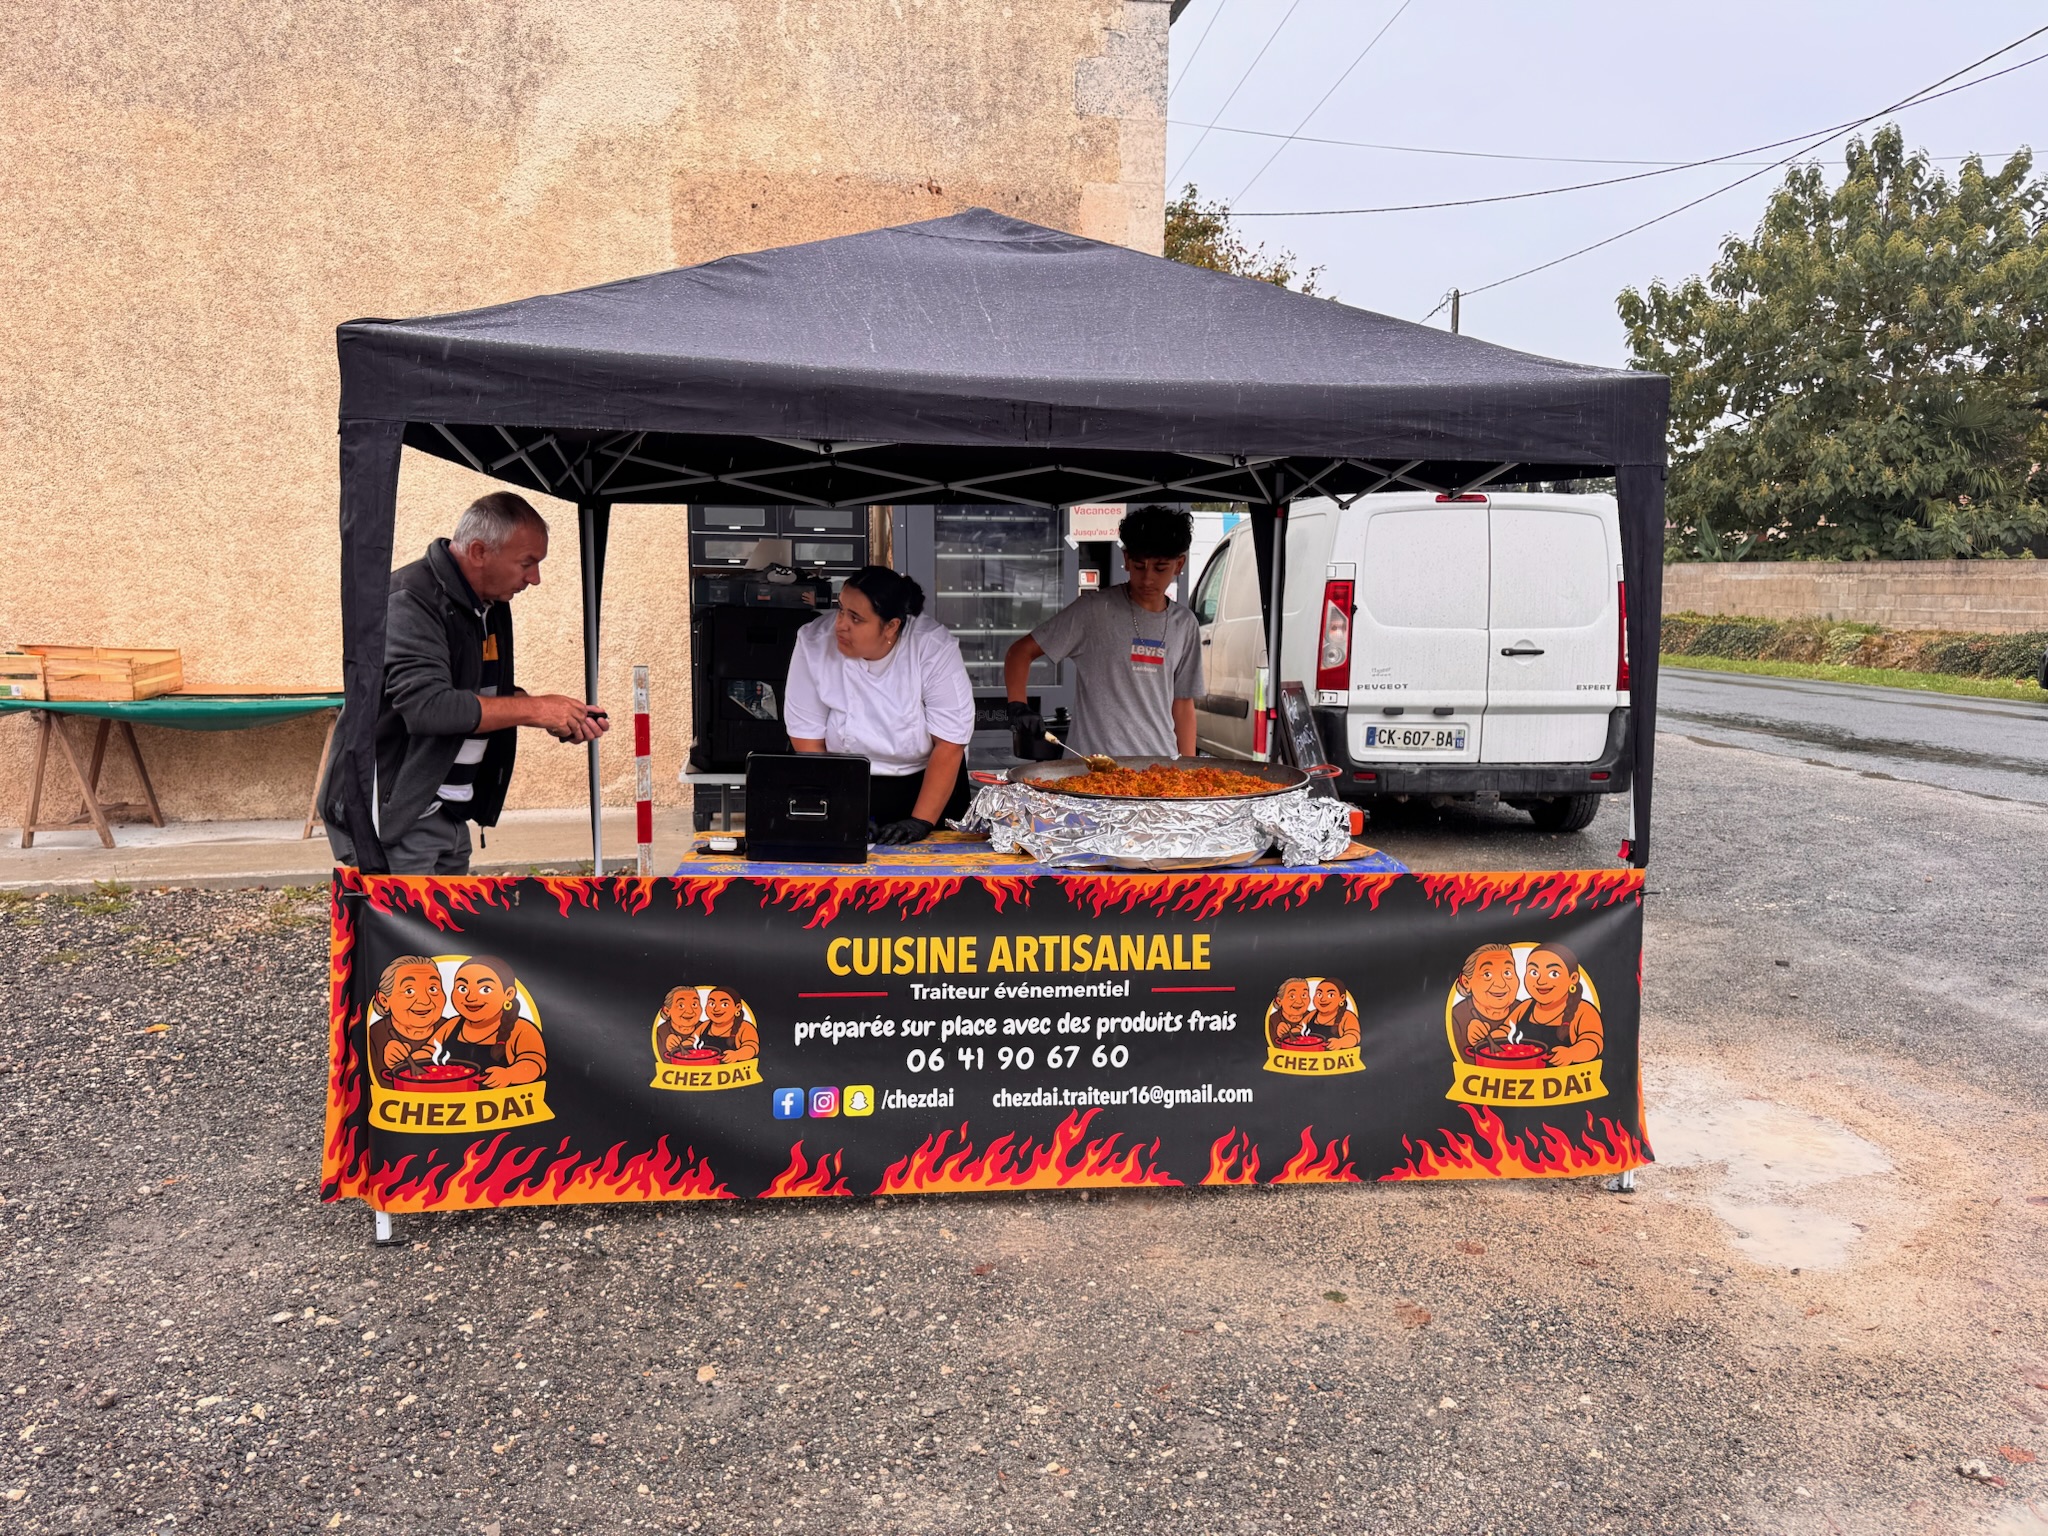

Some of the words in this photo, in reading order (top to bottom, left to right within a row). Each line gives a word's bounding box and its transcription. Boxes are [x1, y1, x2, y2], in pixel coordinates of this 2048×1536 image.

[1074, 507, 1121, 515] Vacances
[1378, 729, 1453, 747] CK-607-BA
[1456, 739, 1464, 748] 16
[826, 936, 977, 976] CUISINE
[987, 934, 1211, 973] ARTISANALE
[910, 982, 989, 1000] Traiteur
[994, 979, 1130, 999] événementiel
[794, 1015, 896, 1046] préparée
[900, 1019, 936, 1037] sur
[941, 1015, 997, 1043] place
[1002, 1016, 1051, 1035] avec
[1057, 1012, 1092, 1034] des
[1096, 1010, 1183, 1040] produits
[1187, 1009, 1237, 1032] frais
[906, 1047, 945, 1073] 06
[957, 1046, 984, 1071] 41
[997, 1046, 1035, 1071] 90
[1047, 1045, 1081, 1069] 67
[1091, 1044, 1129, 1069] 60
[1273, 1054, 1319, 1071] CHEZ
[661, 1070, 712, 1086] CHEZ
[1462, 1074, 1535, 1100] CHEZ
[881, 1087, 955, 1110] /chezdai
[992, 1083, 1254, 1109] chezdai.traiteur16@gmail.com
[379, 1099, 467, 1126] CHEZ
